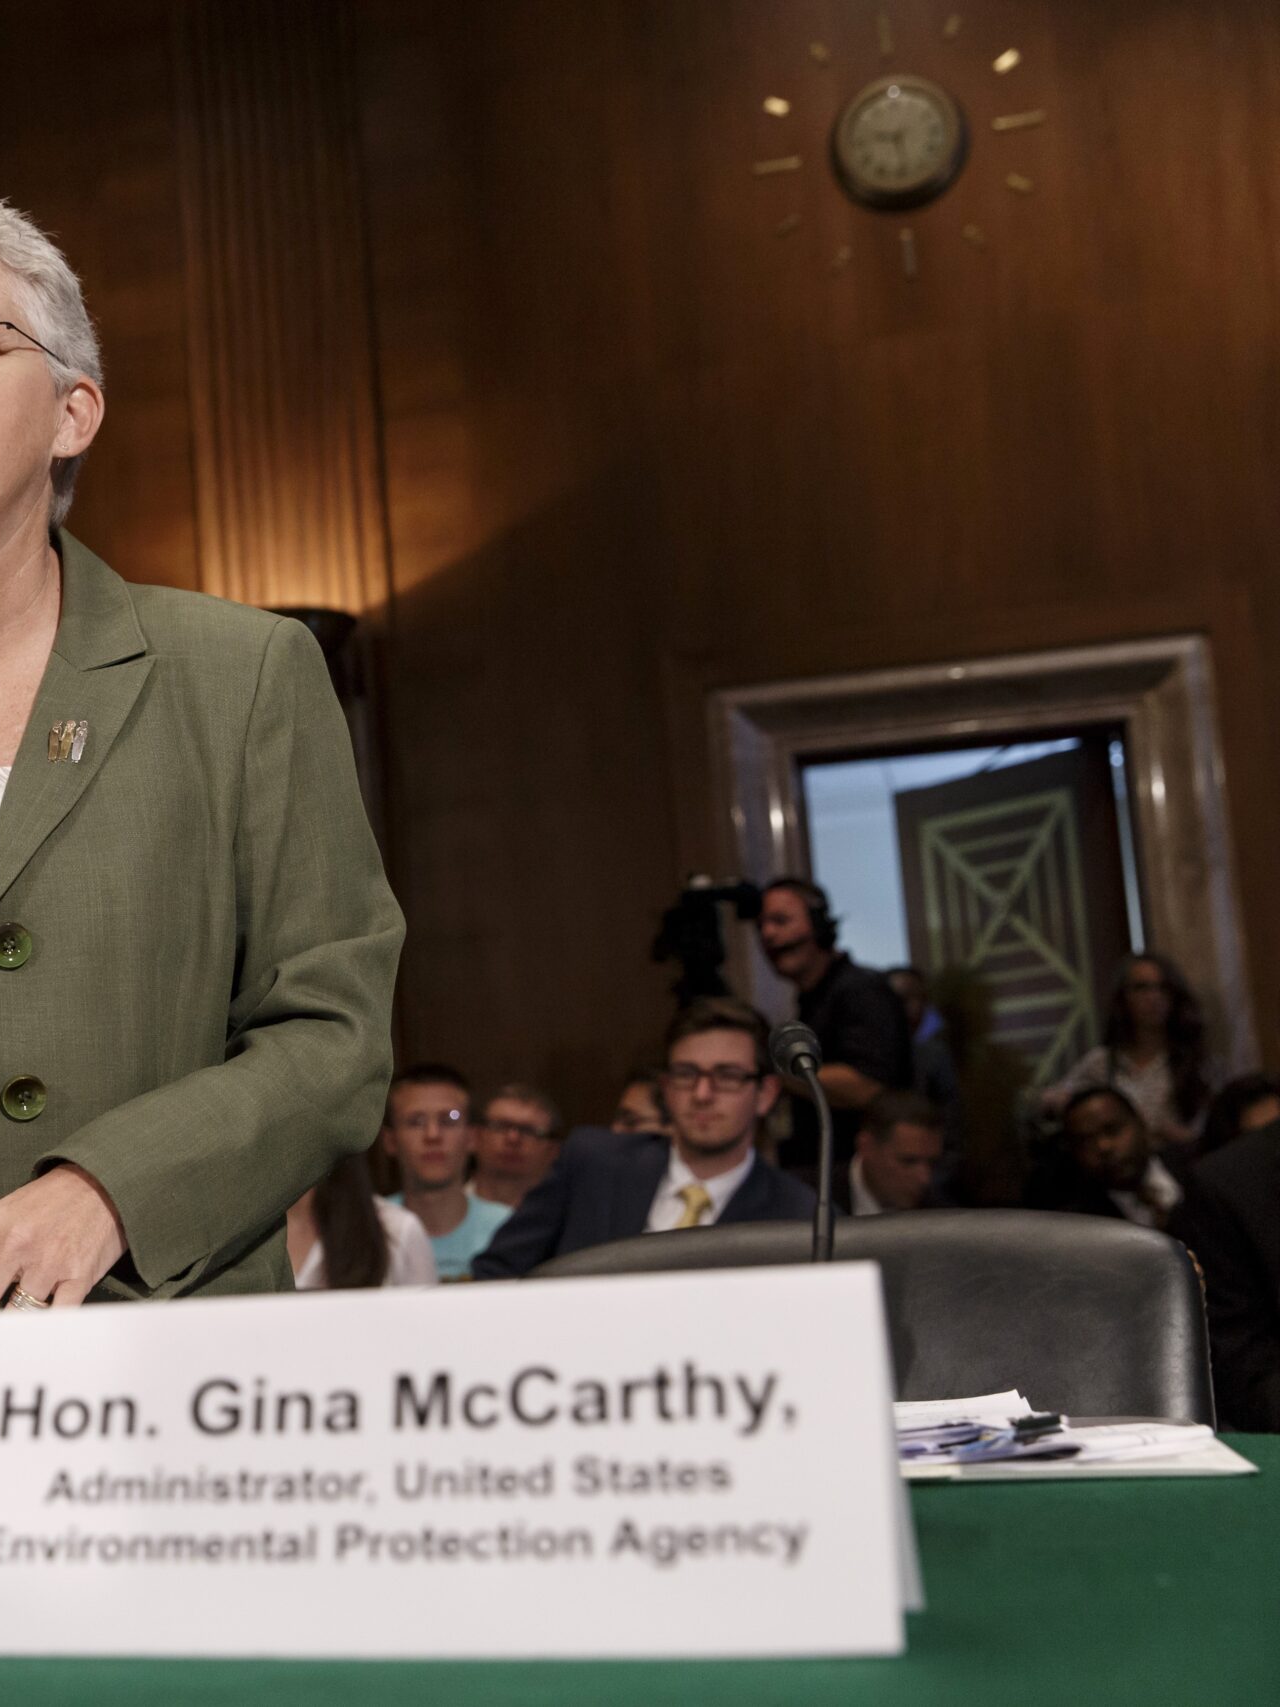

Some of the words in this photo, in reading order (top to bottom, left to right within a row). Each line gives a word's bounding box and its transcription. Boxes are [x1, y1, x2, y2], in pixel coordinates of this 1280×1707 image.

[189, 1377, 361, 1438] Gina
[392, 1360, 797, 1438] McCarthy,
[46, 1466, 375, 1504] Administrator,
[395, 1460, 555, 1501] United
[574, 1455, 732, 1497] States
[334, 1520, 593, 1562] Protection
[610, 1518, 808, 1569] Agency
